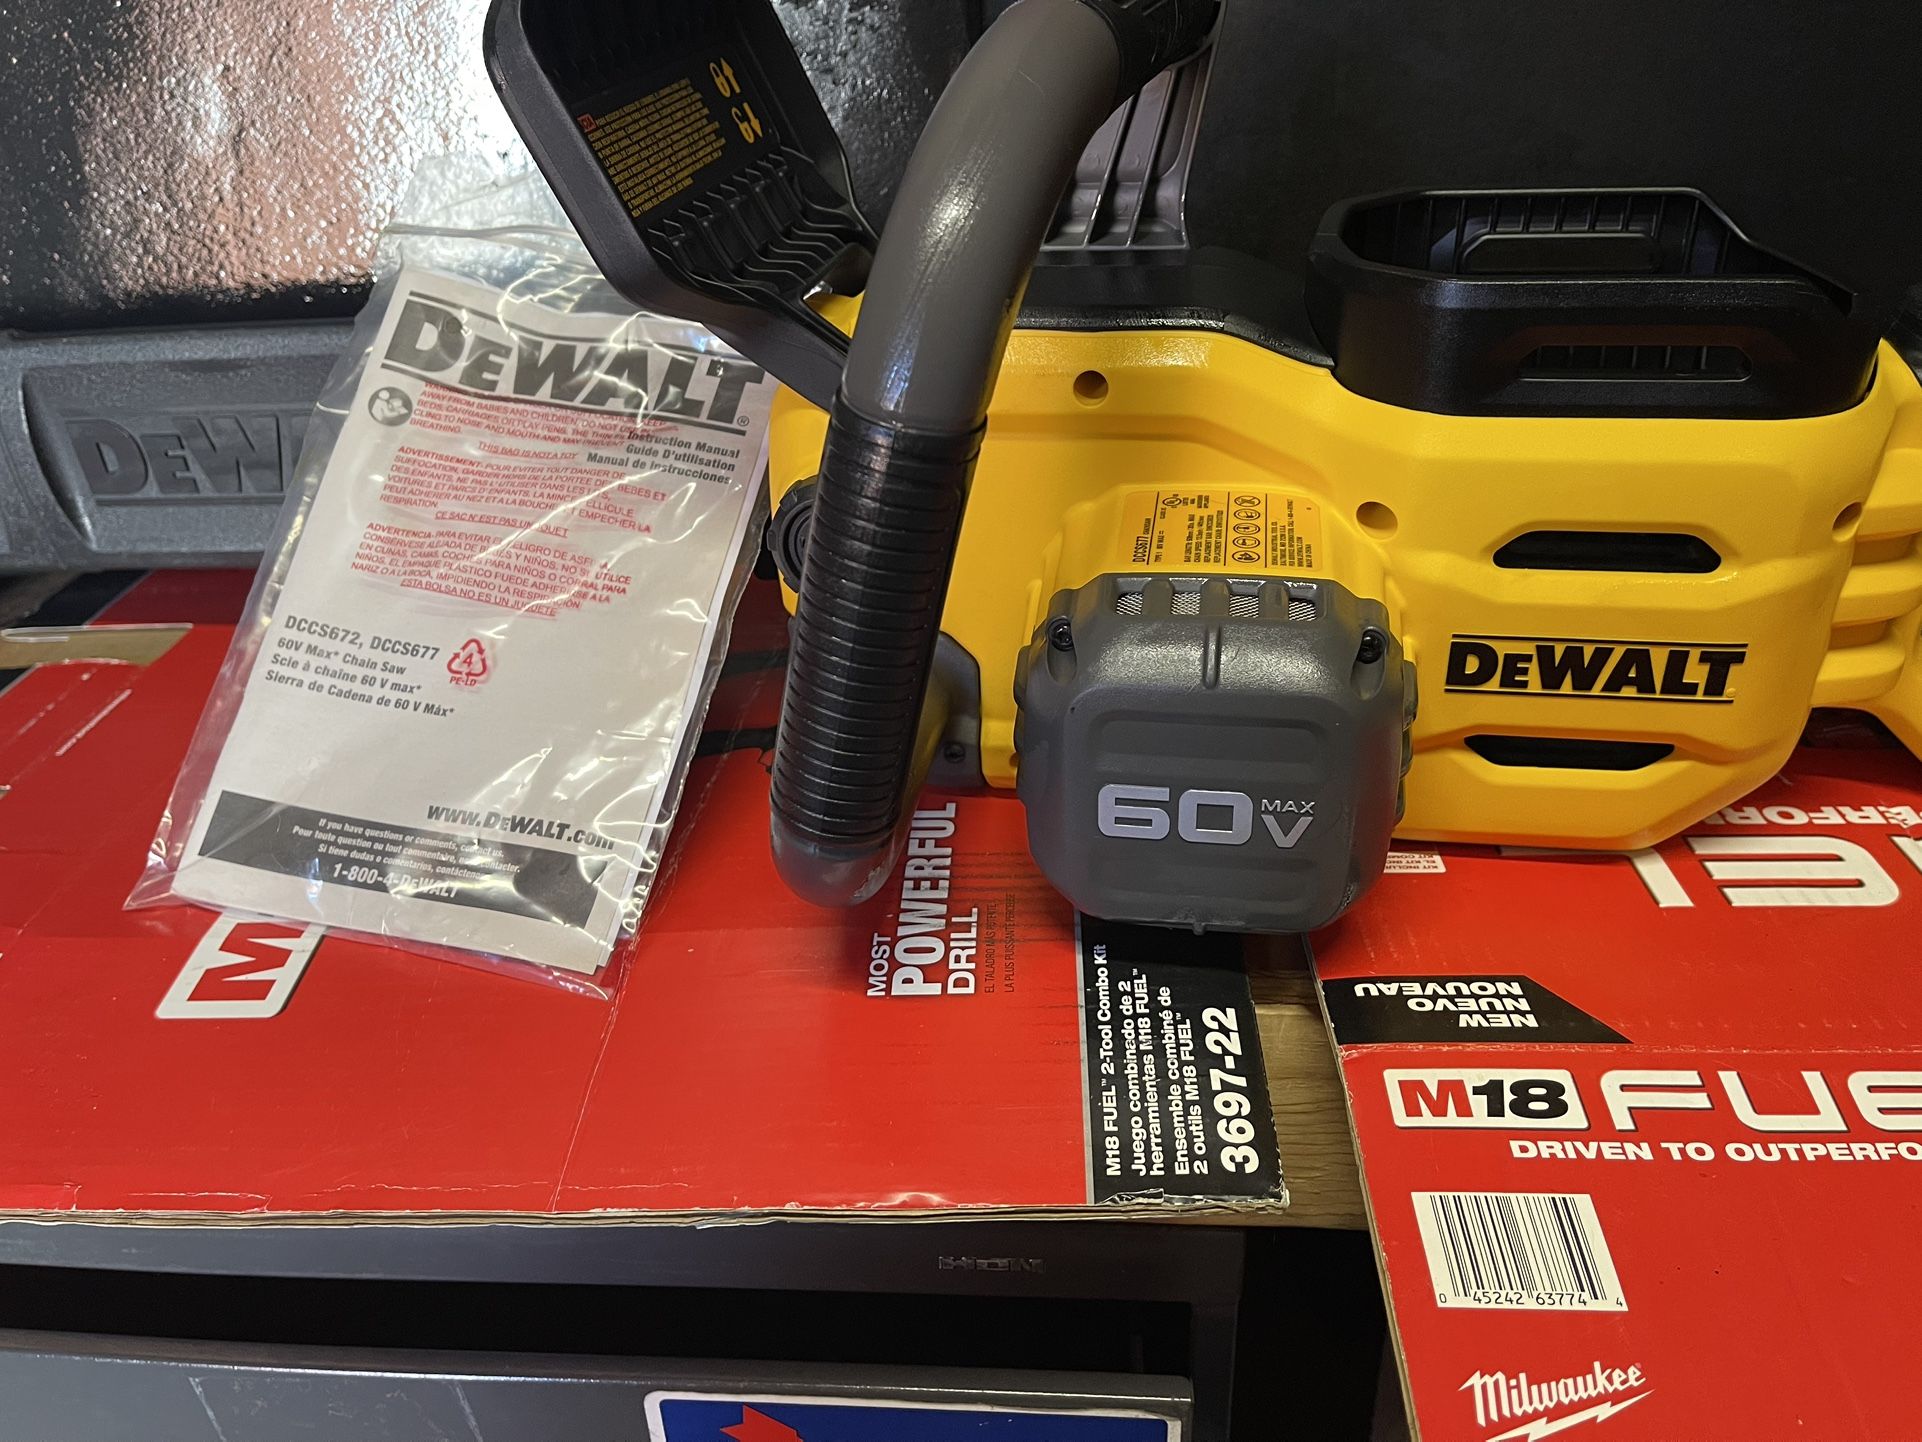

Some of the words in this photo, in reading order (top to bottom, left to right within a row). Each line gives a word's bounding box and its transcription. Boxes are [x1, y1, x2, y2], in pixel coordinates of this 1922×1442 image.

[421, 391, 446, 401] AWAY
[448, 395, 475, 407] FROM
[413, 409, 441, 420] CLING
[444, 414, 455, 423] TO
[626, 444, 660, 457] Guide
[662, 449, 736, 472] D'utilisation
[627, 431, 692, 449] Instruction
[695, 441, 740, 459] Manual
[387, 474, 433, 488] VOITURES
[434, 482, 445, 490] ET
[447, 484, 477, 493] PARCS
[390, 464, 410, 474] DES
[456, 476, 469, 484] NE
[539, 482, 565, 491] DANS
[570, 468, 610, 478] DANGER
[587, 452, 629, 467] Manual
[632, 458, 647, 469] de
[650, 461, 732, 484] instrucciones
[383, 483, 407, 495] PEUT
[407, 490, 453, 499] ADHERER
[453, 493, 465, 501] AU
[578, 509, 636, 530] EMPECHER
[435, 510, 449, 520] CE
[450, 512, 467, 521] SAC
[480, 515, 498, 524] EST
[499, 517, 518, 528] PAS
[363, 532, 426, 549] CONSERVESE
[464, 544, 478, 553] DE
[515, 552, 523, 561] Y
[561, 564, 577, 575] NO
[595, 571, 632, 585] UTILICE
[458, 532, 492, 543] EVITAR
[553, 549, 568, 560] DE
[351, 562, 378, 573] NARIZ
[436, 571, 496, 591] IMPIDIENDO
[500, 585, 512, 595] LA
[359, 541, 374, 551] EN
[484, 559, 512, 572] PARA
[513, 562, 547, 579] NIÑOS
[548, 572, 557, 581] O
[601, 583, 628, 595] PARA
[388, 558, 401, 566] EL
[494, 571, 529, 587] PUEDE
[400, 578, 423, 589] ESTA
[425, 581, 458, 595] BOLSA
[459, 587, 476, 599] NO
[478, 591, 493, 602] ES
[494, 595, 510, 605] UN
[284, 615, 365, 648] DCCS672,
[370, 635, 440, 661] DCCS677
[271, 654, 300, 669] Scie
[301, 661, 311, 672] à
[314, 663, 358, 684] chaîne
[360, 675, 377, 687] 60
[379, 677, 390, 689] V
[277, 637, 304, 652] 60V
[342, 654, 378, 671] Chain
[380, 660, 407, 675] Saw
[462, 652, 475, 668] 4
[265, 670, 305, 688] Sierra
[307, 680, 325, 693] de
[327, 685, 374, 704] Cadena
[376, 695, 393, 708] de
[394, 698, 410, 710] 60
[412, 701, 422, 712] V
[450, 676, 477, 687] PE-LD
[1097, 782, 1254, 845] 60
[1260, 799, 1316, 815] MAX
[292, 825, 313, 837] Pour
[314, 830, 336, 842] toute
[337, 836, 373, 849] question
[386, 843, 402, 853] tout
[404, 847, 457, 864] commentaire,
[319, 818, 326, 827] If
[327, 820, 343, 831] you
[344, 823, 364, 834] have
[364, 828, 403, 841] questions
[415, 837, 458, 852] comments,
[492, 848, 505, 858] us.
[1260, 814, 1314, 849] V
[318, 844, 328, 853] Si
[328, 845, 349, 857] tiene
[349, 850, 379, 862] dudas
[383, 856, 434, 873] comentarios,
[891, 801, 957, 997] POWERFUL
[947, 907, 978, 994] DRILL
[1005, 923, 1015, 960] PUISSANTE
[1094, 944, 1107, 965] Kit
[866, 932, 891, 996] MOST
[985, 949, 995, 982] TALADRO
[1004, 962, 1015, 980] PLUS
[984, 984, 994, 993] EL
[1004, 983, 1014, 993] LA
[1095, 967, 1111, 1021] Combo
[1118, 980, 1131, 992] 2
[1157, 986, 1172, 1006] de
[1354, 982, 1524, 996] NOUVEAU
[1119, 995, 1132, 1015] de
[1407, 998, 1531, 1011] NUEVO
[1459, 1013, 1539, 1027] NEW
[1098, 1025, 1115, 1075] 2-Tool
[1136, 1017, 1152, 1050] M18
[1158, 1009, 1180, 1080] combiné
[1122, 1018, 1142, 1112] combinado
[1182, 1065, 1200, 1101] M18
[1201, 1007, 1260, 1174] 3697-22
[1399, 1078, 1570, 1118] M18
[1142, 1054, 1165, 1176] herramientas
[1168, 1084, 1190, 1175] Ensemble
[1188, 1104, 1206, 1155] outils
[1104, 1136, 1122, 1176] M18
[1130, 1116, 1147, 1176] Juego
[1508, 1140, 1660, 1162] DRIVEN
[1662, 1142, 1716, 1162] TO
[1193, 1160, 1209, 1175] 2
[1439, 1293, 1447, 1303] 0
[1473, 1291, 1525, 1305] 45242
[1535, 1293, 1587, 1306] 63774
[1458, 1361, 1646, 1427] Milwaukee
